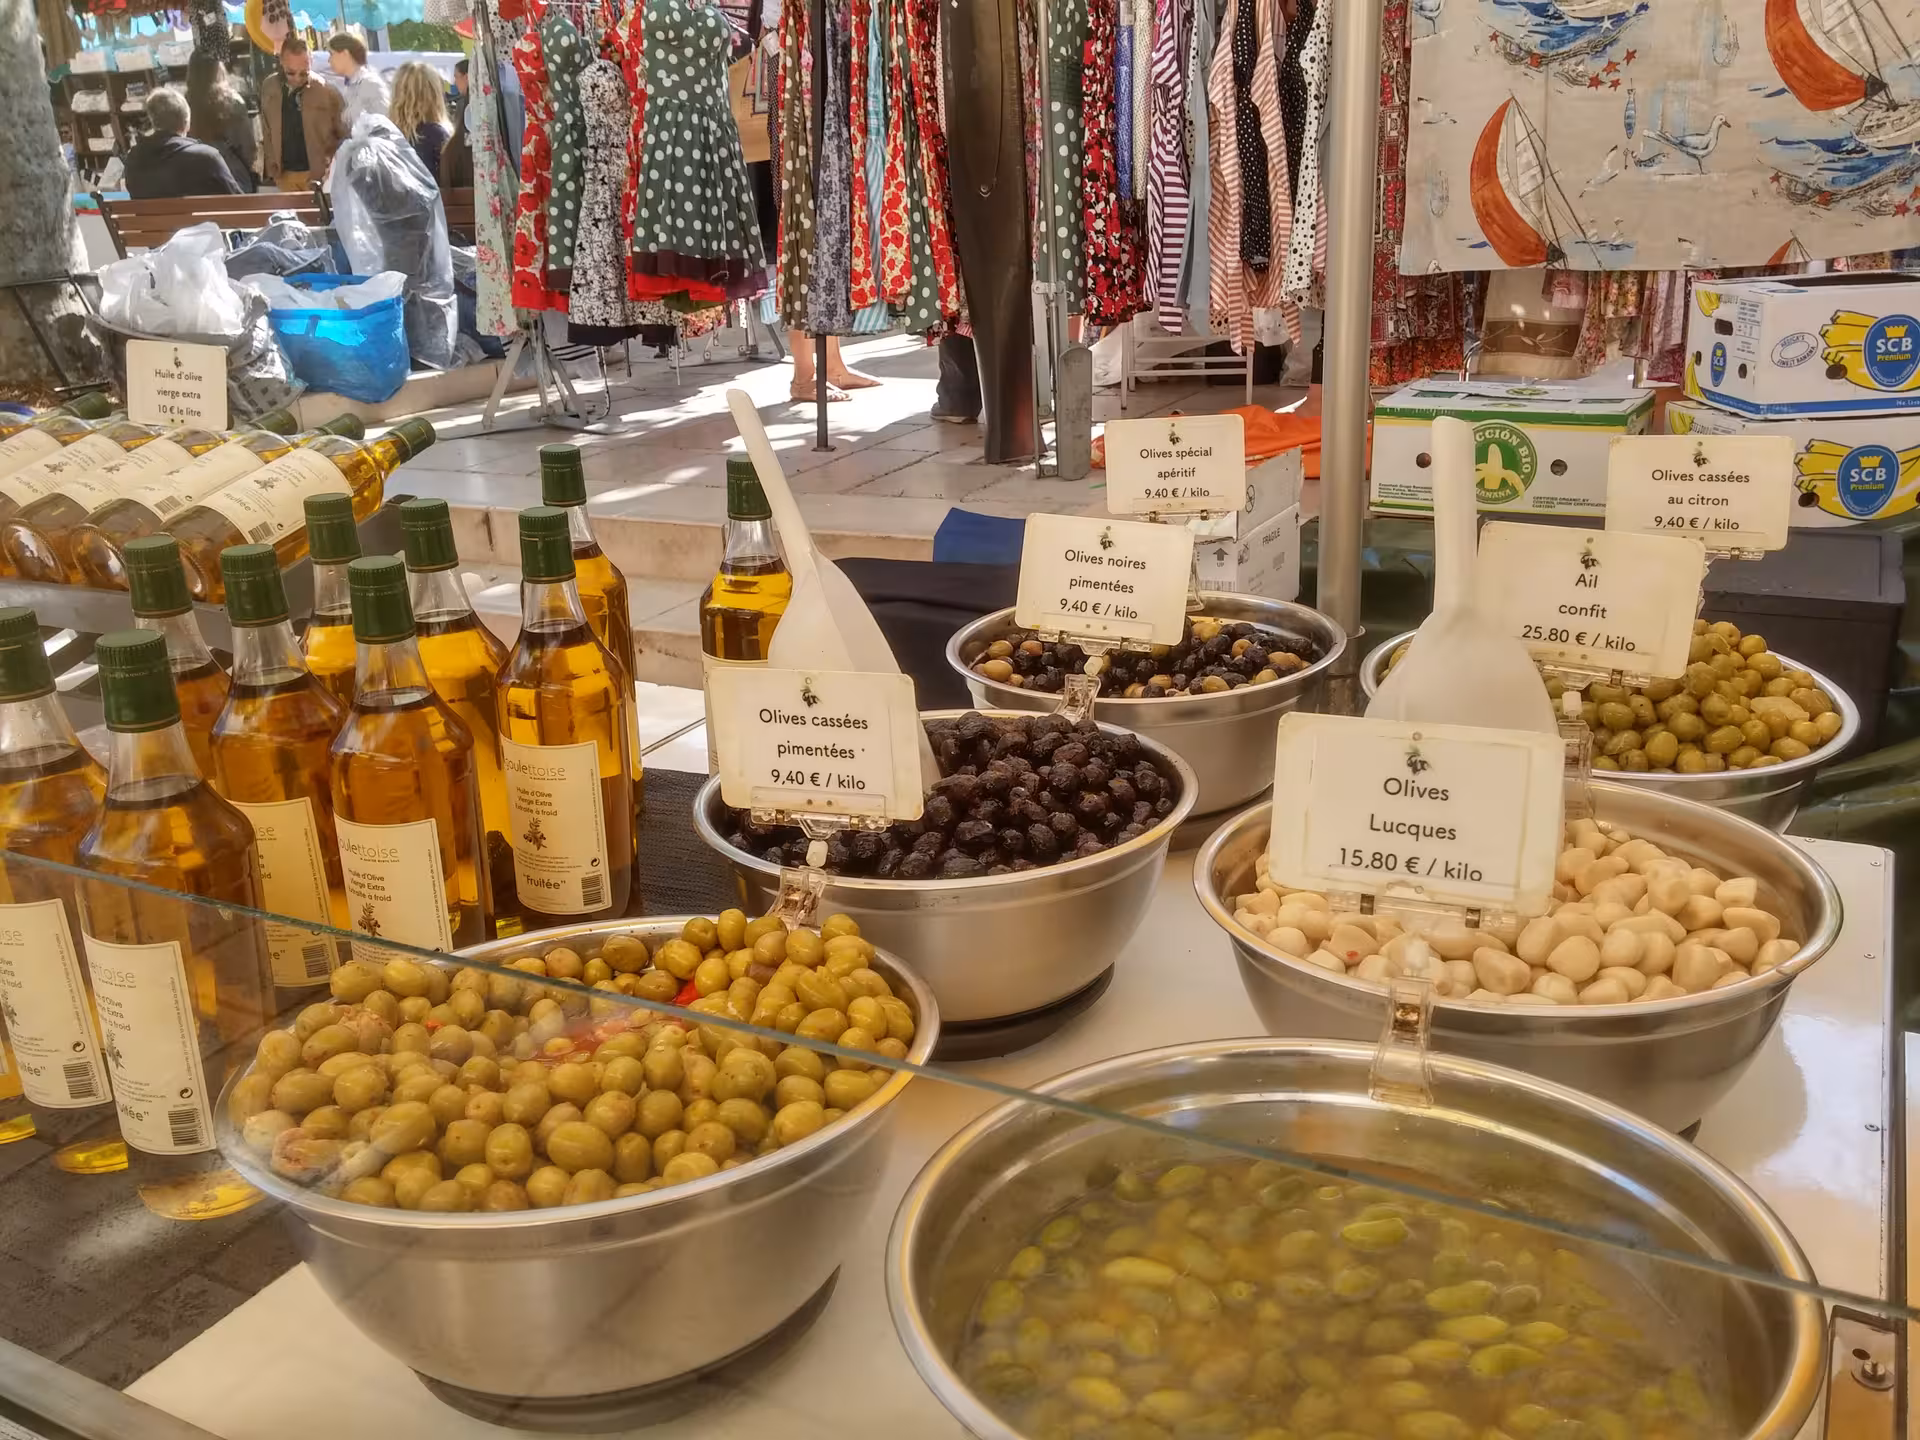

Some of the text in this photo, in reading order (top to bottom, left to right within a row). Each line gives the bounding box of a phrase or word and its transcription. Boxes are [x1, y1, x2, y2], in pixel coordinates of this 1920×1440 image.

[1876, 337, 1913, 353] SCB
[1712, 356, 1725, 367] SCB
[1876, 353, 1912, 363] Premium
[154, 369, 203, 382] Huile d'olive
[157, 387, 201, 400] vierge extra
[158, 404, 202, 417] 10 € le litre
[1475, 428, 1520, 446] CCIÓN
[1139, 446, 1213, 461] Olives spécial
[1157, 467, 1196, 481] apéritif
[1651, 469, 1751, 483] Olives cassées
[1850, 468, 1887, 482] SCB
[1171, 487, 1179, 497] €
[1182, 487, 1187, 498] /
[1190, 487, 1210, 497] kilo
[1850, 482, 1885, 491] Premium
[1667, 494, 1729, 507] au citron
[1654, 515, 1740, 530] 9,40 € / kilo
[1262, 527, 1281, 546] FRAGILE
[1064, 549, 1147, 570] Olives noires
[1069, 576, 1134, 594] pimentées
[1574, 573, 1599, 589] Ail
[1060, 598, 1138, 619] 9,40 € / kilo
[1558, 603, 1608, 619] confit
[1521, 624, 1636, 652] 25,80 € / kilo
[759, 708, 869, 730] Olives cassées
[777, 740, 855, 759] pimentées
[771, 768, 866, 790] 9,40 € / kilo
[1383, 777, 1450, 801] Olives
[535, 799, 553, 807] Extra
[541, 809, 558, 817] froid
[1369, 813, 1457, 842] Lucques
[1340, 847, 1483, 882] 15,80 € / kilo
[367, 882, 386, 892] Extra
[373, 894, 392, 902] froid
[90, 961, 136, 984] ettoise
